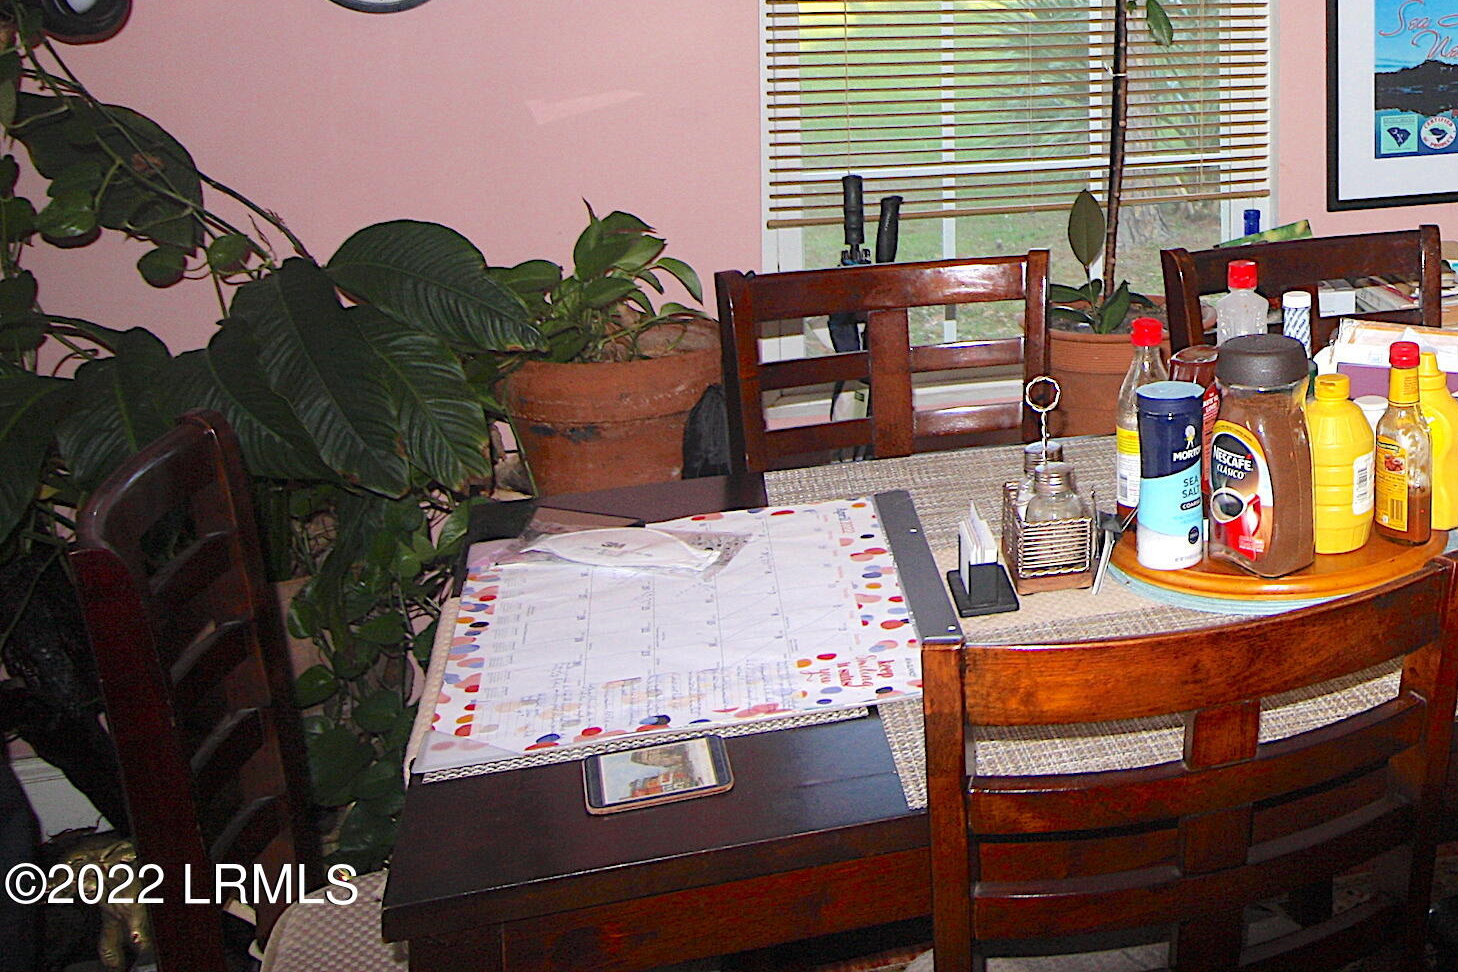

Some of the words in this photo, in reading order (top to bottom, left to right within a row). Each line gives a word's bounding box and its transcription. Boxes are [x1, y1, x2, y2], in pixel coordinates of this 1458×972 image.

[1184, 476, 1199, 488] SEA
[833, 508, 851, 522] April
[840, 522, 855, 534] 2022
[800, 668, 833, 684] you
[848, 654, 878, 688] Smiling
[876, 660, 895, 678] keep
